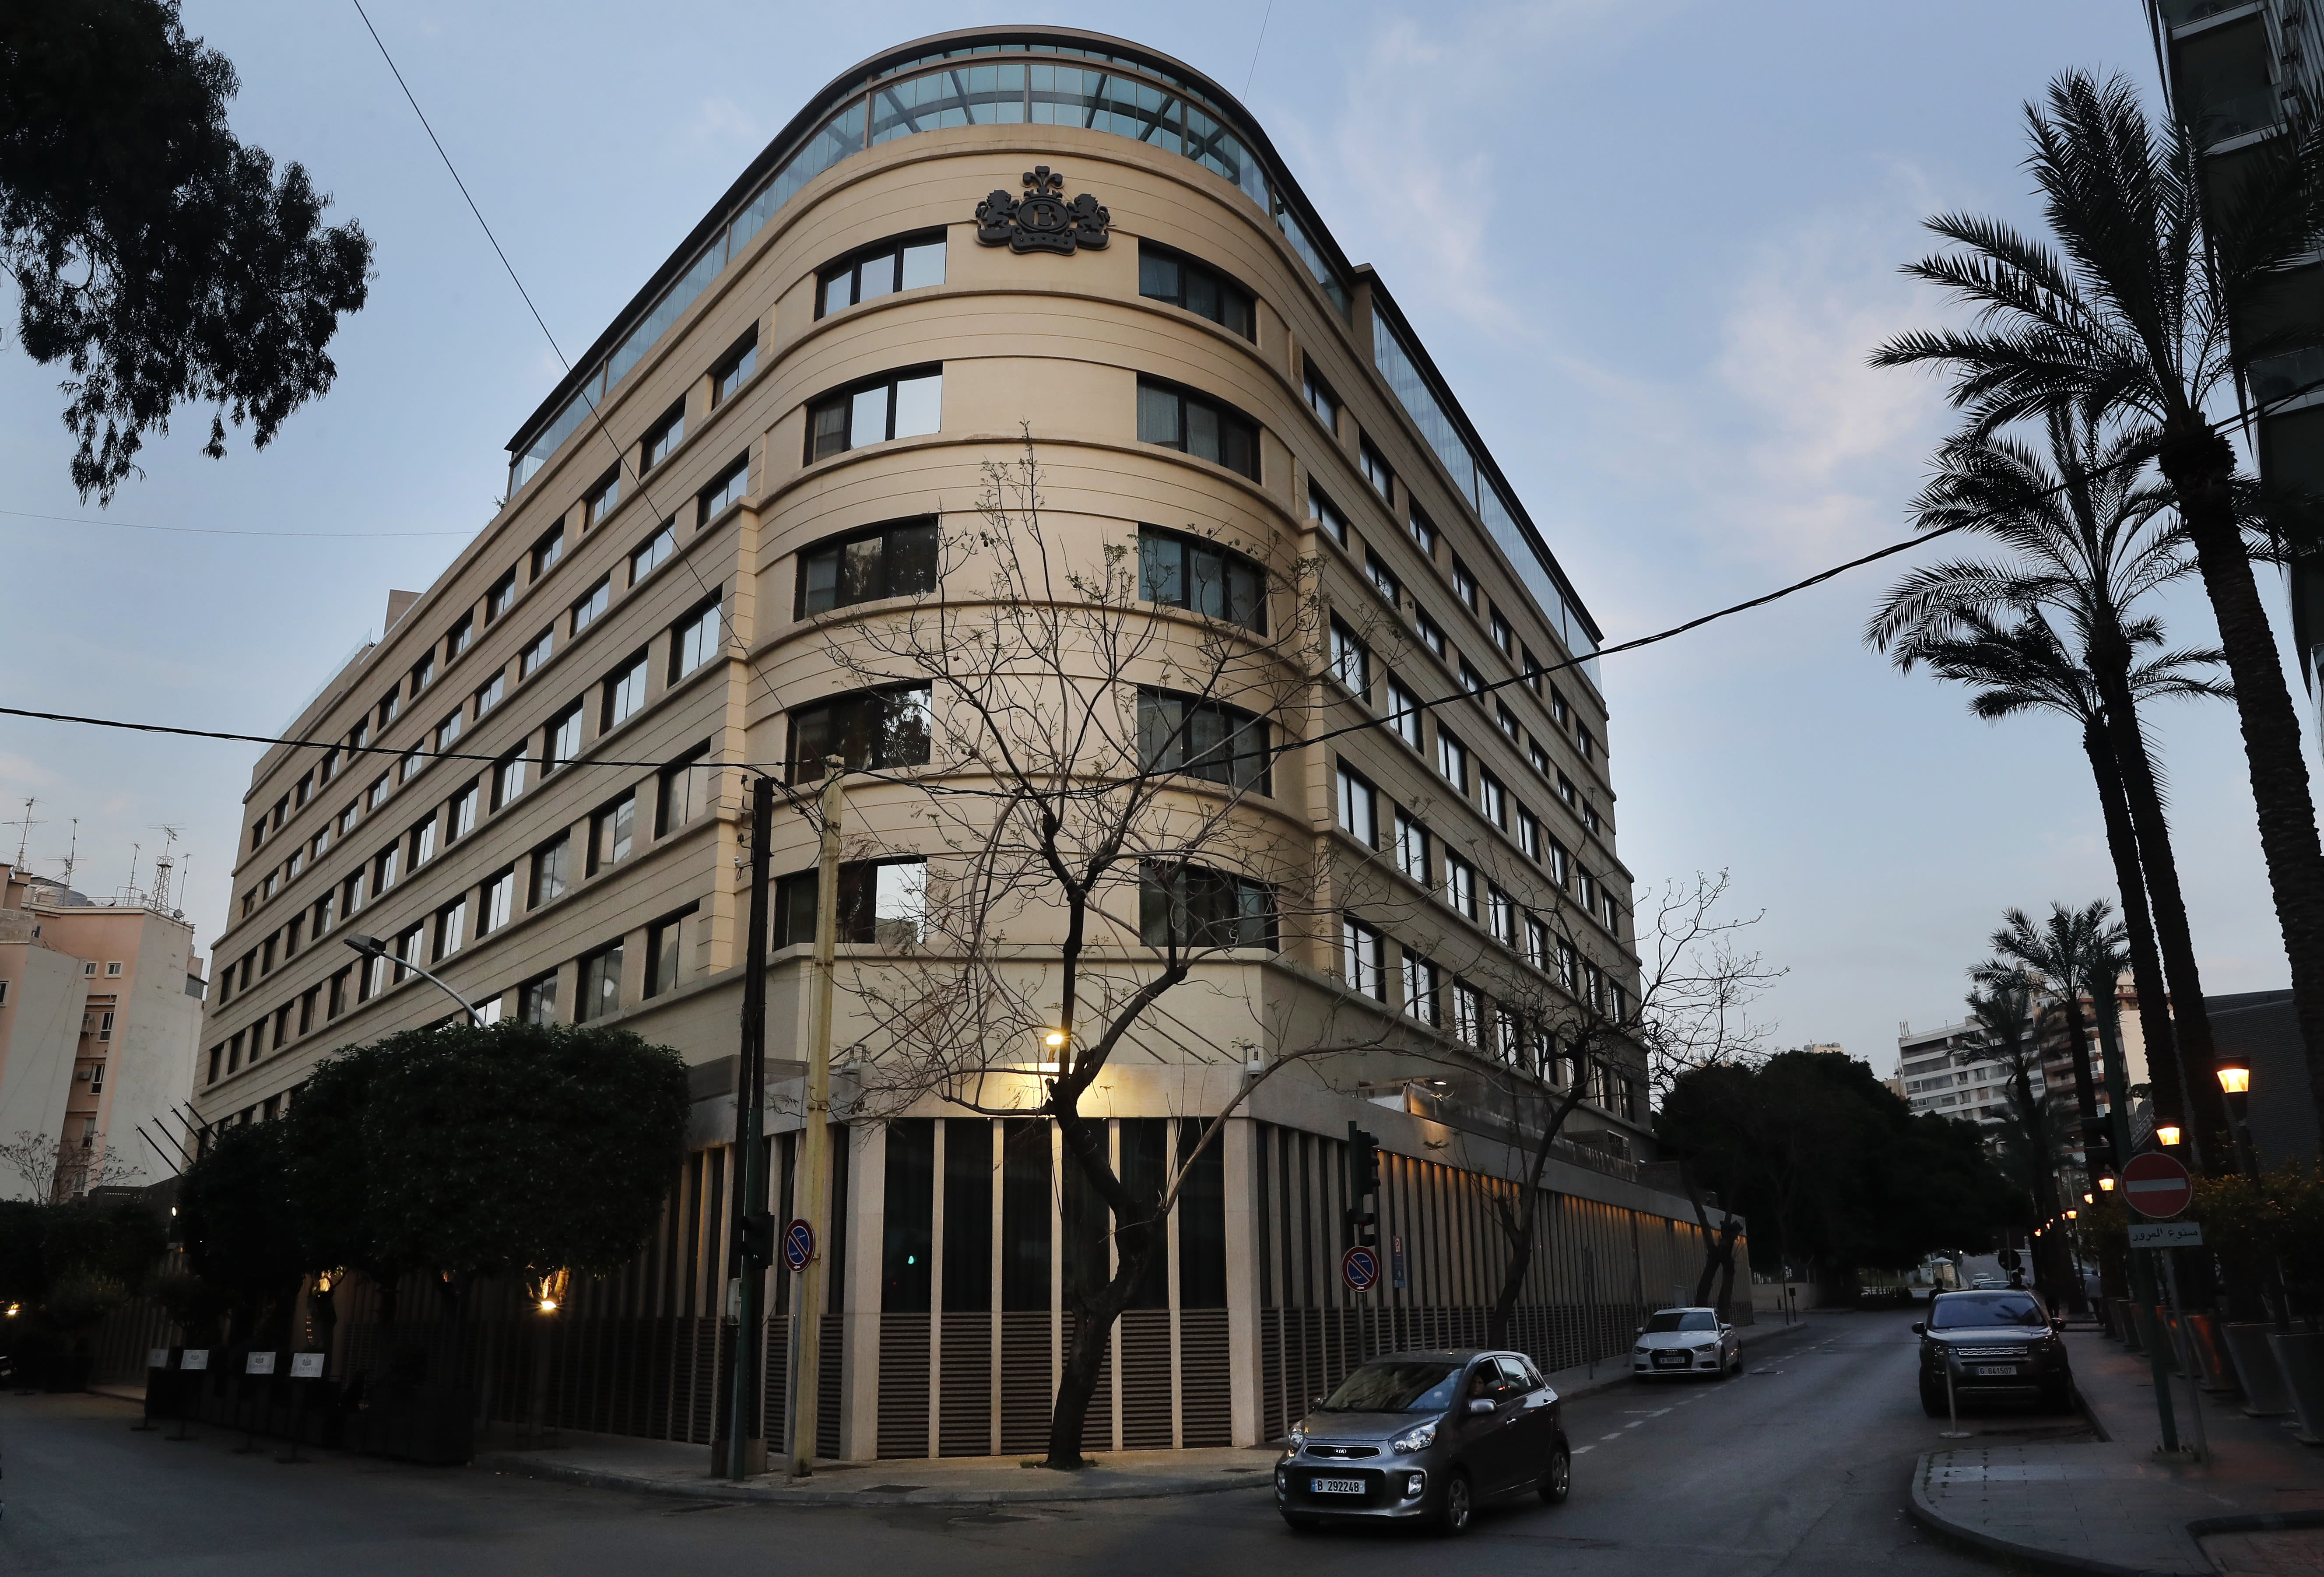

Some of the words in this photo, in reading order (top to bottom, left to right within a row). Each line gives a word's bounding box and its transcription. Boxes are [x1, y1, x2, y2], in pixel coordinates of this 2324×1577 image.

[2132, 1228, 2163, 1241] المرور
[1317, 1480, 1323, 1491] B
[1328, 1481, 1359, 1492] 292248
